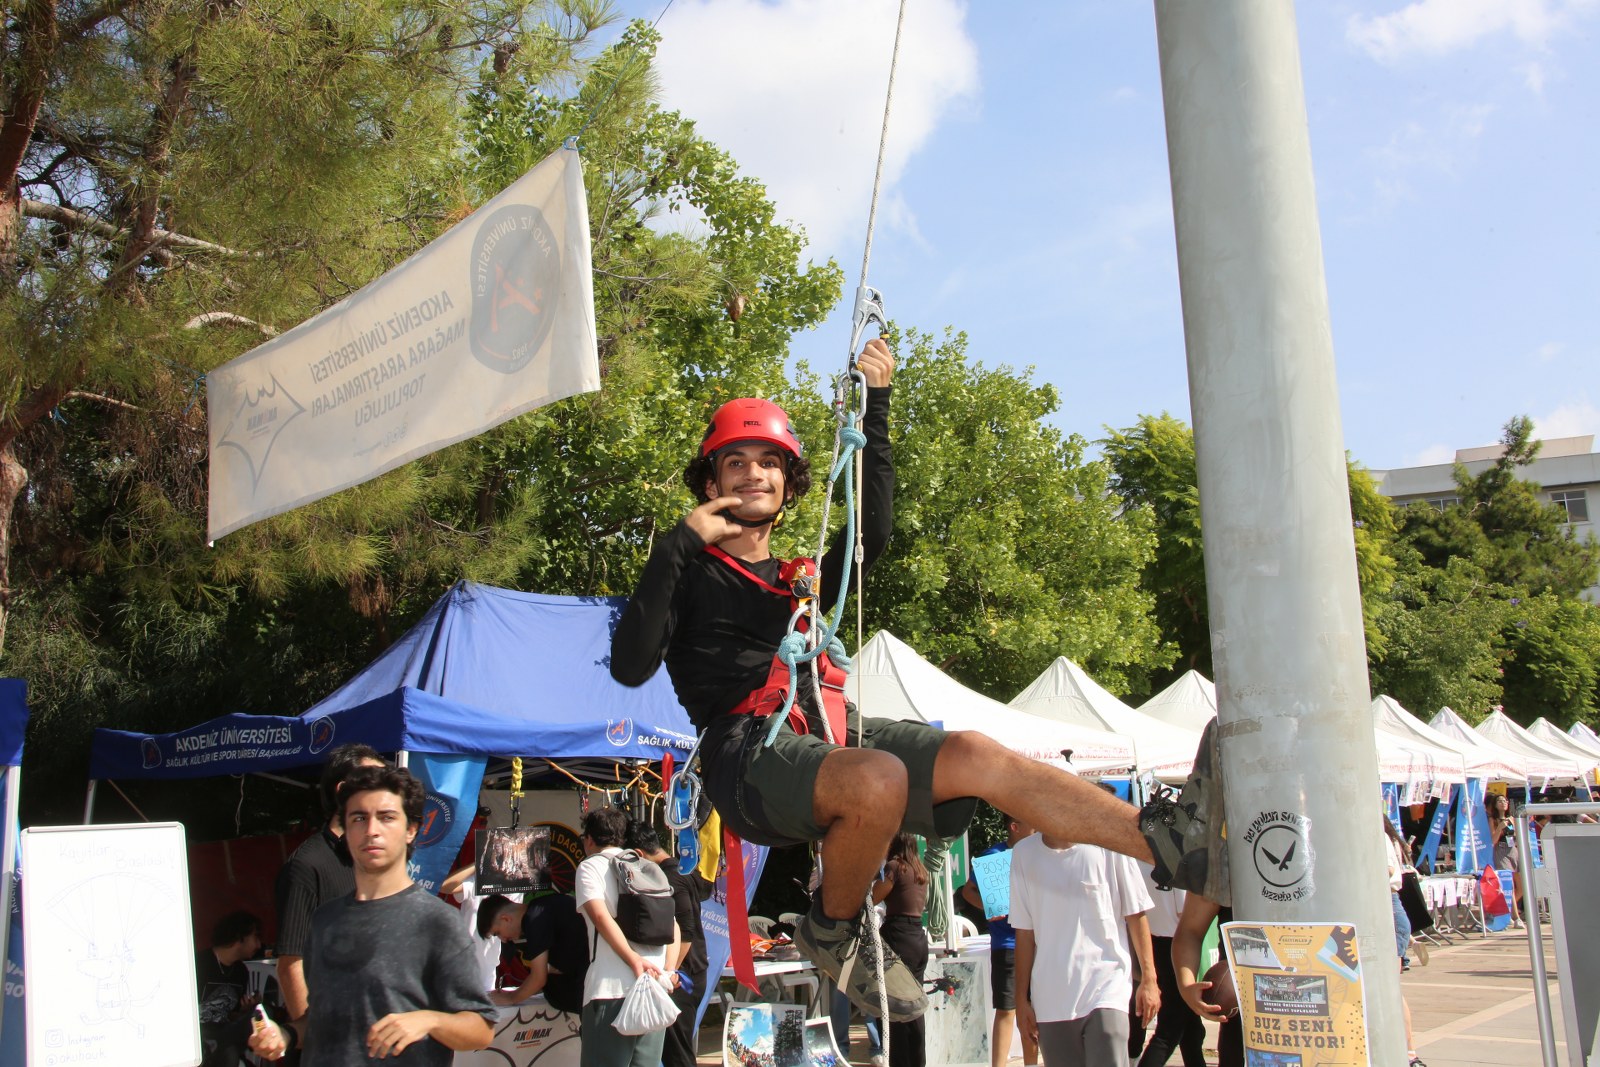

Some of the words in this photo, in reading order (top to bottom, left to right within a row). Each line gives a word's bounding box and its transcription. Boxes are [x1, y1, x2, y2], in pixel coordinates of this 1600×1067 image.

[220, 723, 293, 747] ÜNİVERSİTESİ
[637, 734, 672, 749] SAĞLIK,
[219, 748, 237, 761] SPOR
[1254, 1016, 1281, 1029] BUZ
[1288, 1017, 1334, 1033] SENİ
[1250, 1029, 1345, 1049] ÇAĞIRIYOR!
